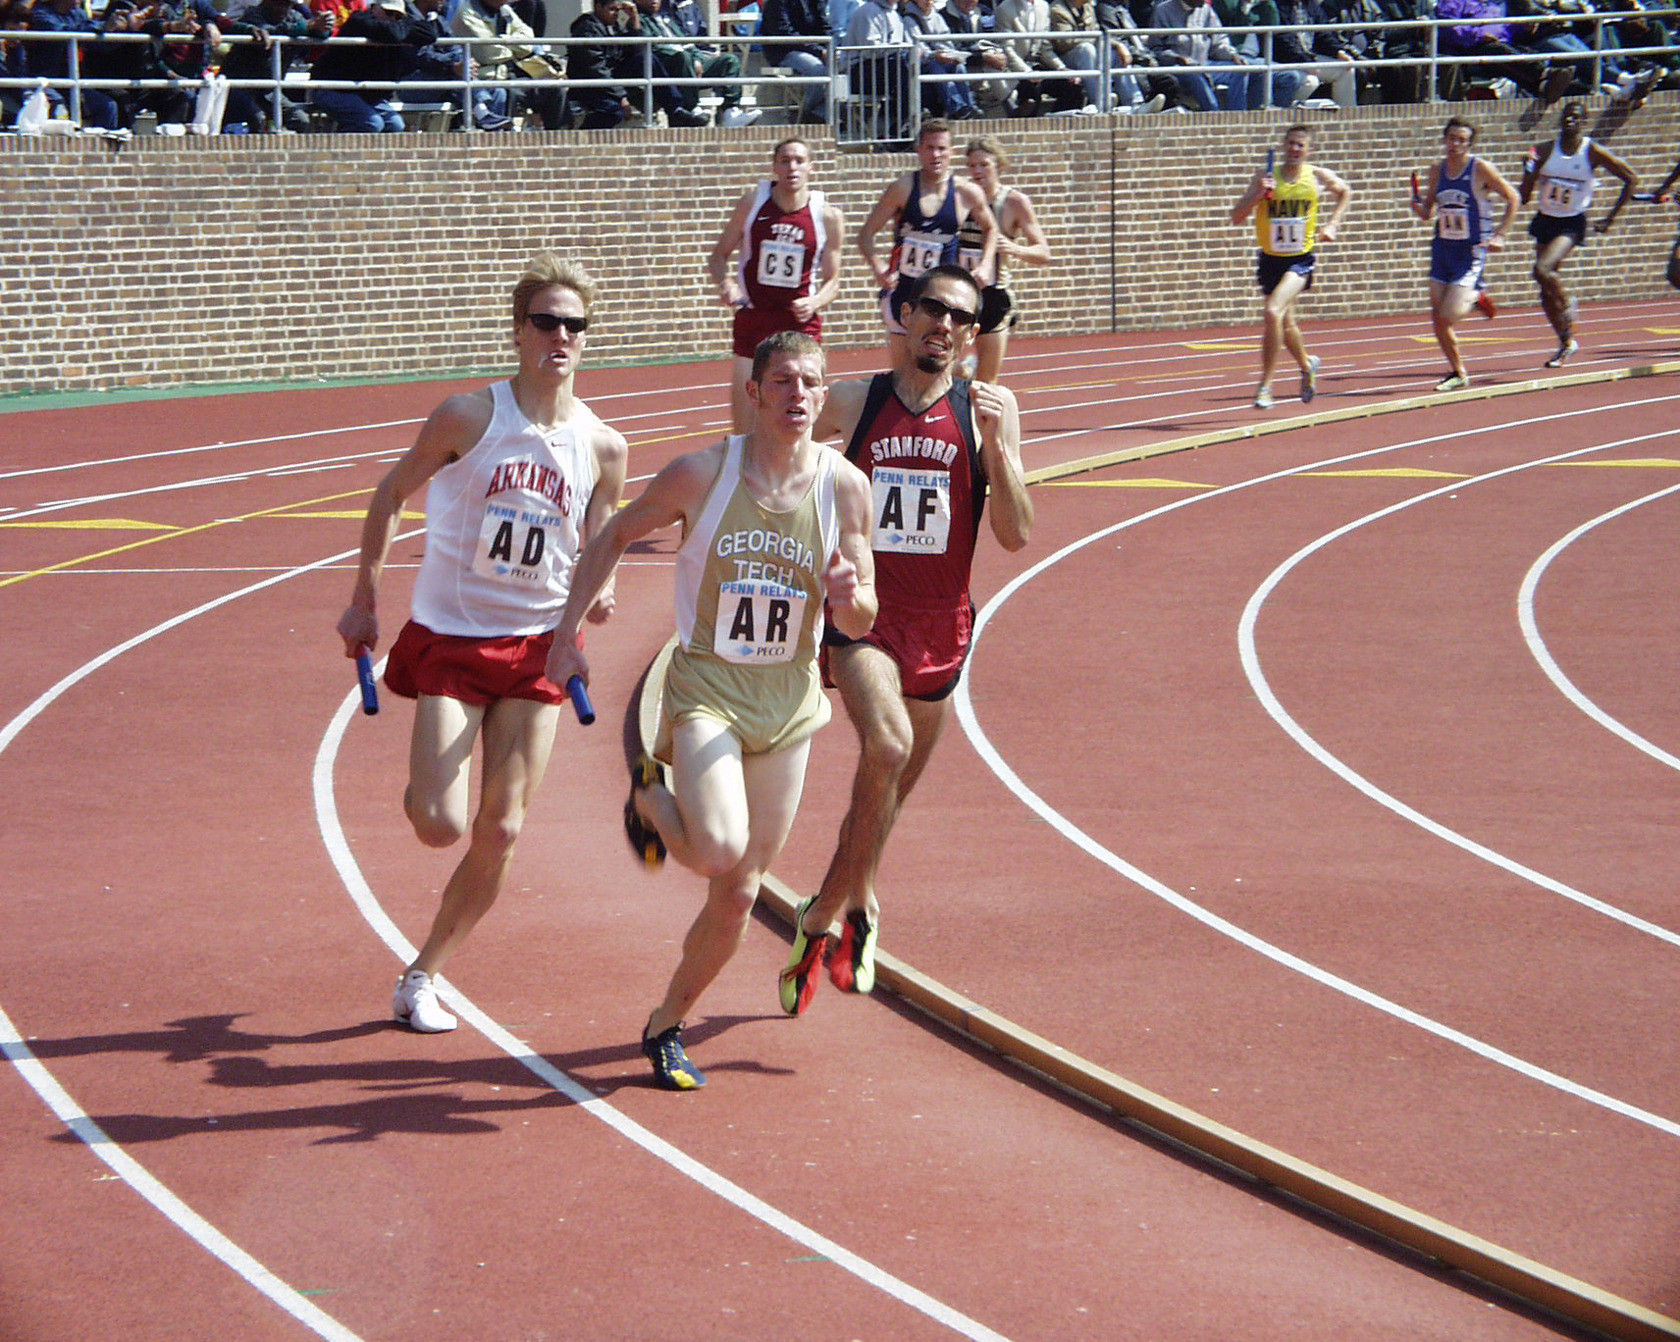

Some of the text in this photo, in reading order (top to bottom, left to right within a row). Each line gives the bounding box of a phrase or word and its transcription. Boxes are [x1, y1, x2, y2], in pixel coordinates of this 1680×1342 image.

[1268, 198, 1312, 219] NAVY
[1275, 225, 1298, 243] AL
[765, 252, 795, 277] CS
[870, 435, 959, 468] STANFORD
[485, 461, 572, 518] ARKANSAS
[873, 469, 951, 489] PENN RELAYS
[486, 502, 562, 528] PENN RELAYS
[879, 486, 938, 532] AF
[488, 520, 546, 568] AD
[717, 529, 815, 574] GEORGIA
[905, 534, 936, 546] PECO
[733, 558, 795, 588] TECH
[721, 581, 807, 601] PENN RELAYS
[729, 595, 791, 644] AR
[756, 646, 786, 657] PECO
